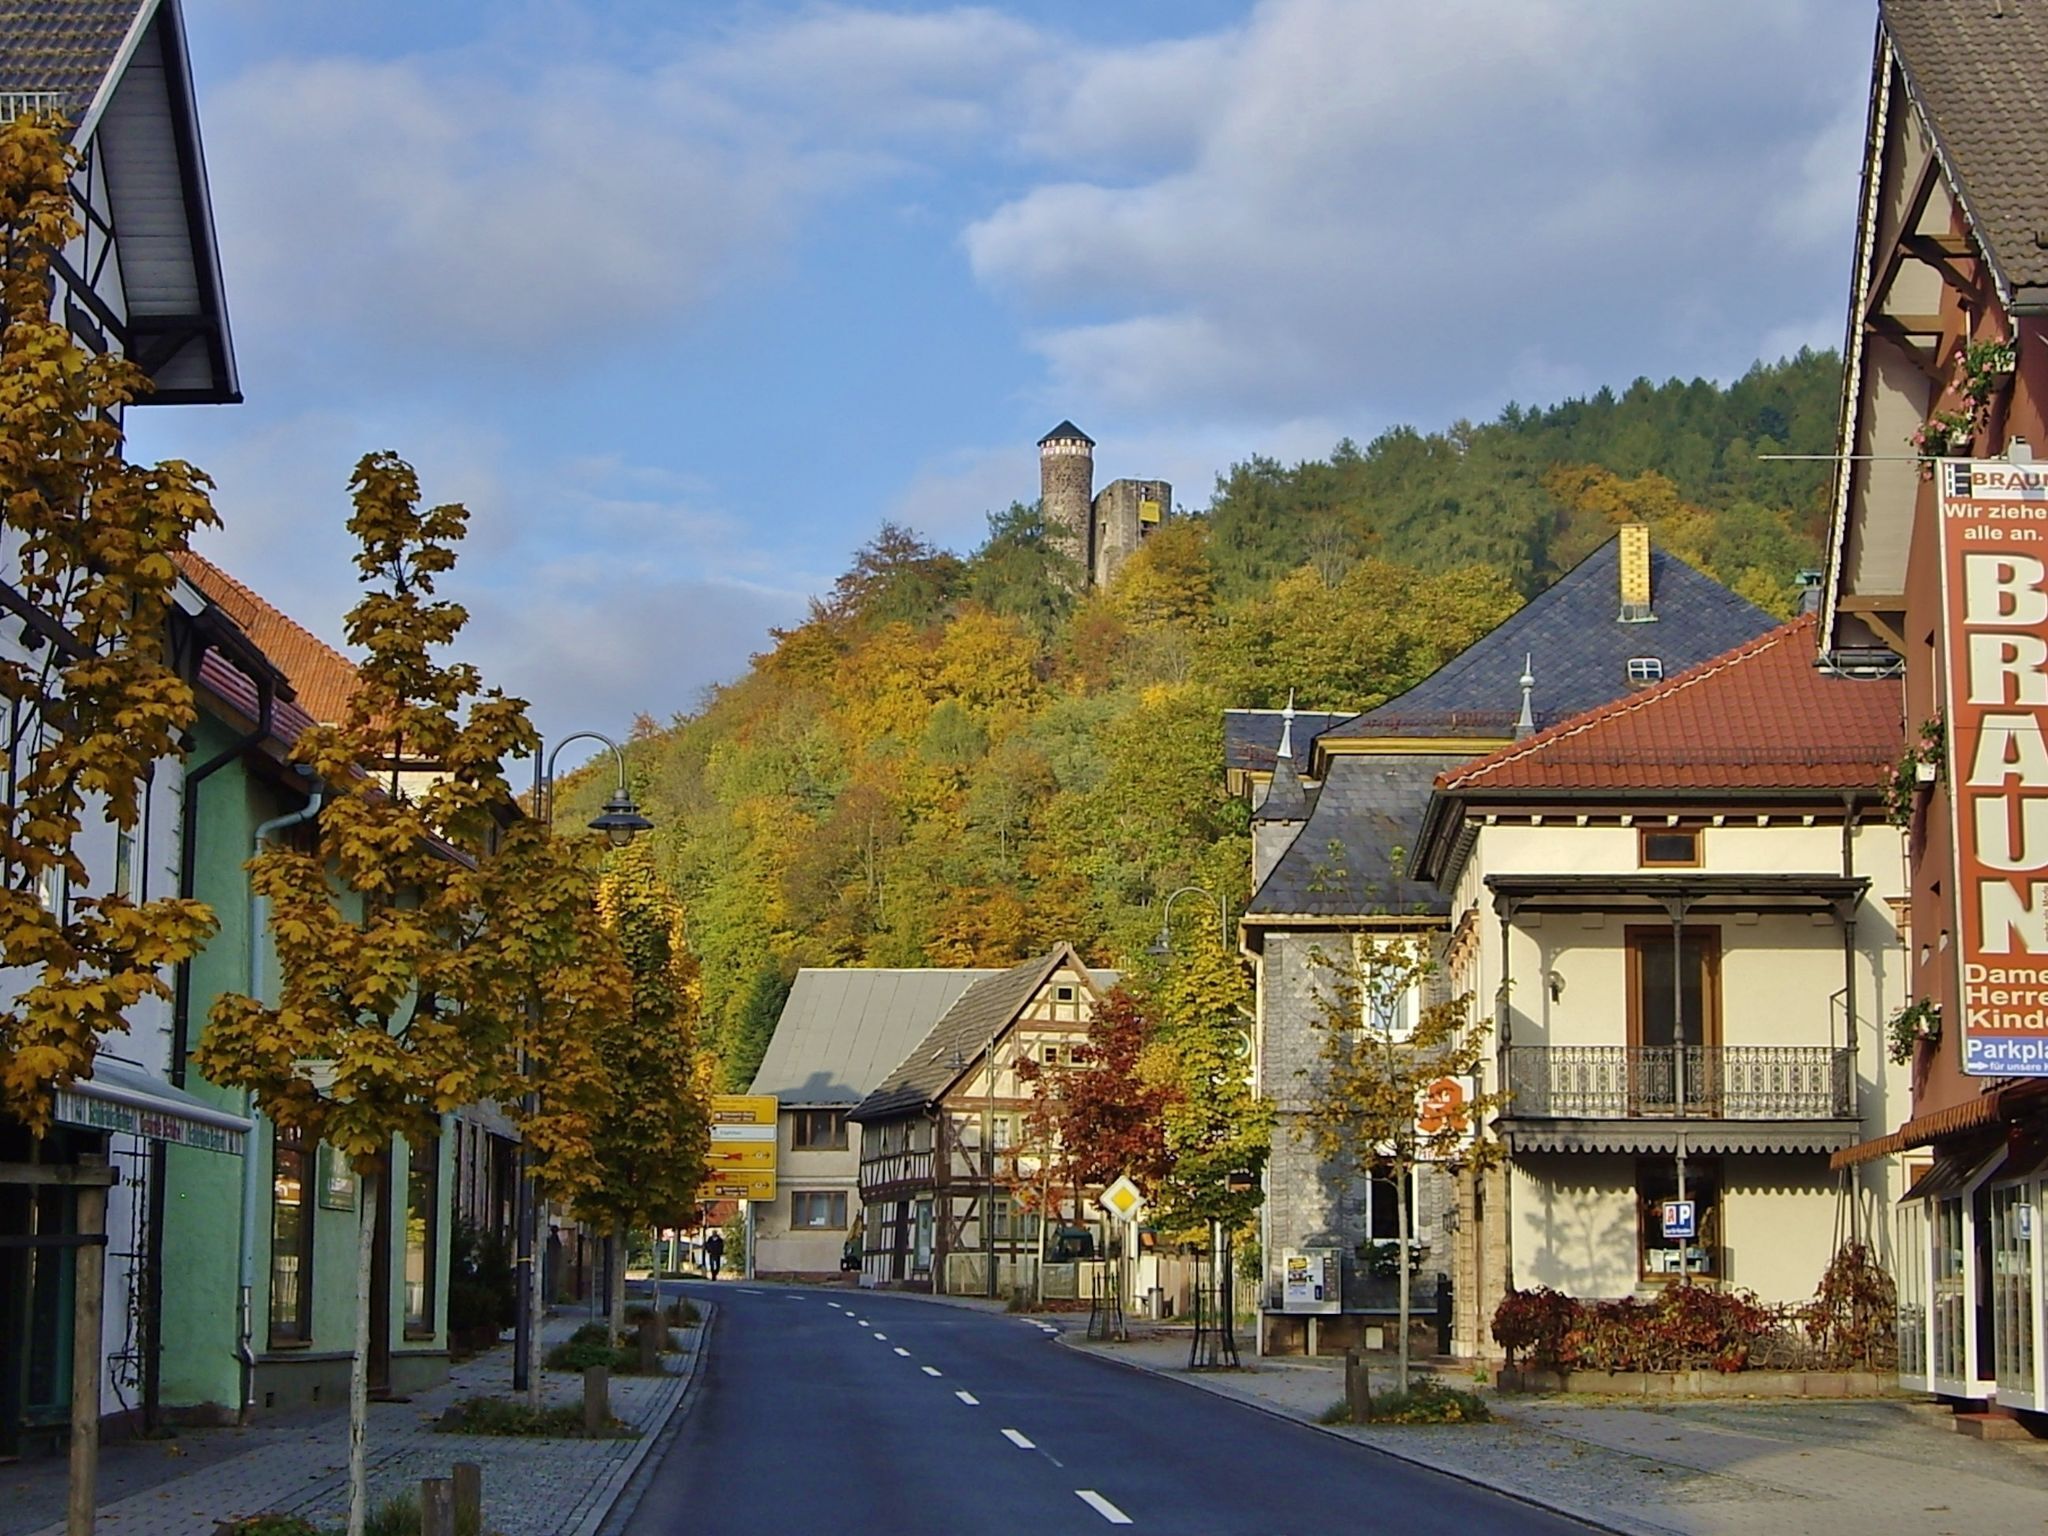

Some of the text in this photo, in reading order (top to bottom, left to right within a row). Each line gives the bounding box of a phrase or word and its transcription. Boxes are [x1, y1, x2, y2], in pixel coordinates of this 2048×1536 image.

[1944, 504, 1983, 519] Wir
[1964, 525, 2044, 541] alle an.
[1967, 1008, 2048, 1029] Kind
[1679, 1205, 1691, 1225] P
